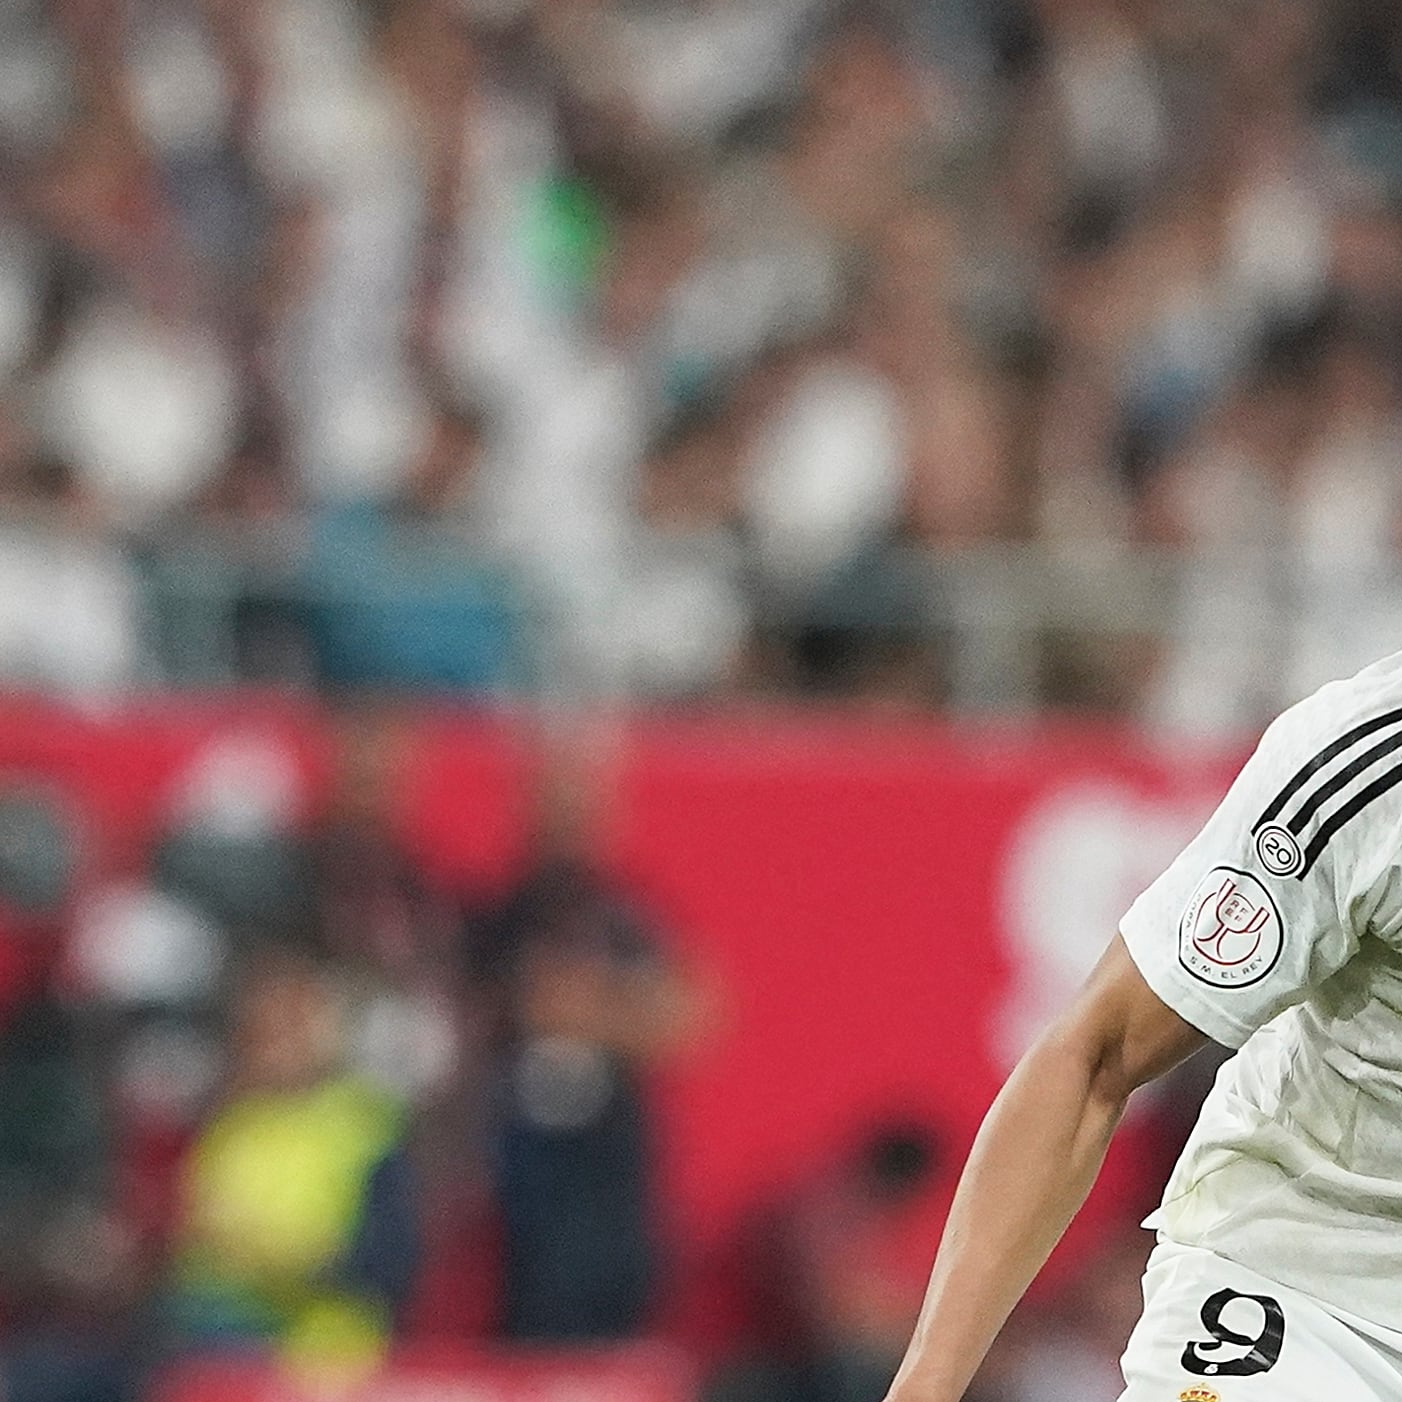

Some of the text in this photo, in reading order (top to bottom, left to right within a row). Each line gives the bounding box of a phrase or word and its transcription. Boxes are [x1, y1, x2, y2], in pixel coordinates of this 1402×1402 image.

[1265, 837, 1292, 865] 20
[1242, 956, 1263, 976] REY
[1181, 1288, 1285, 1377] 9
